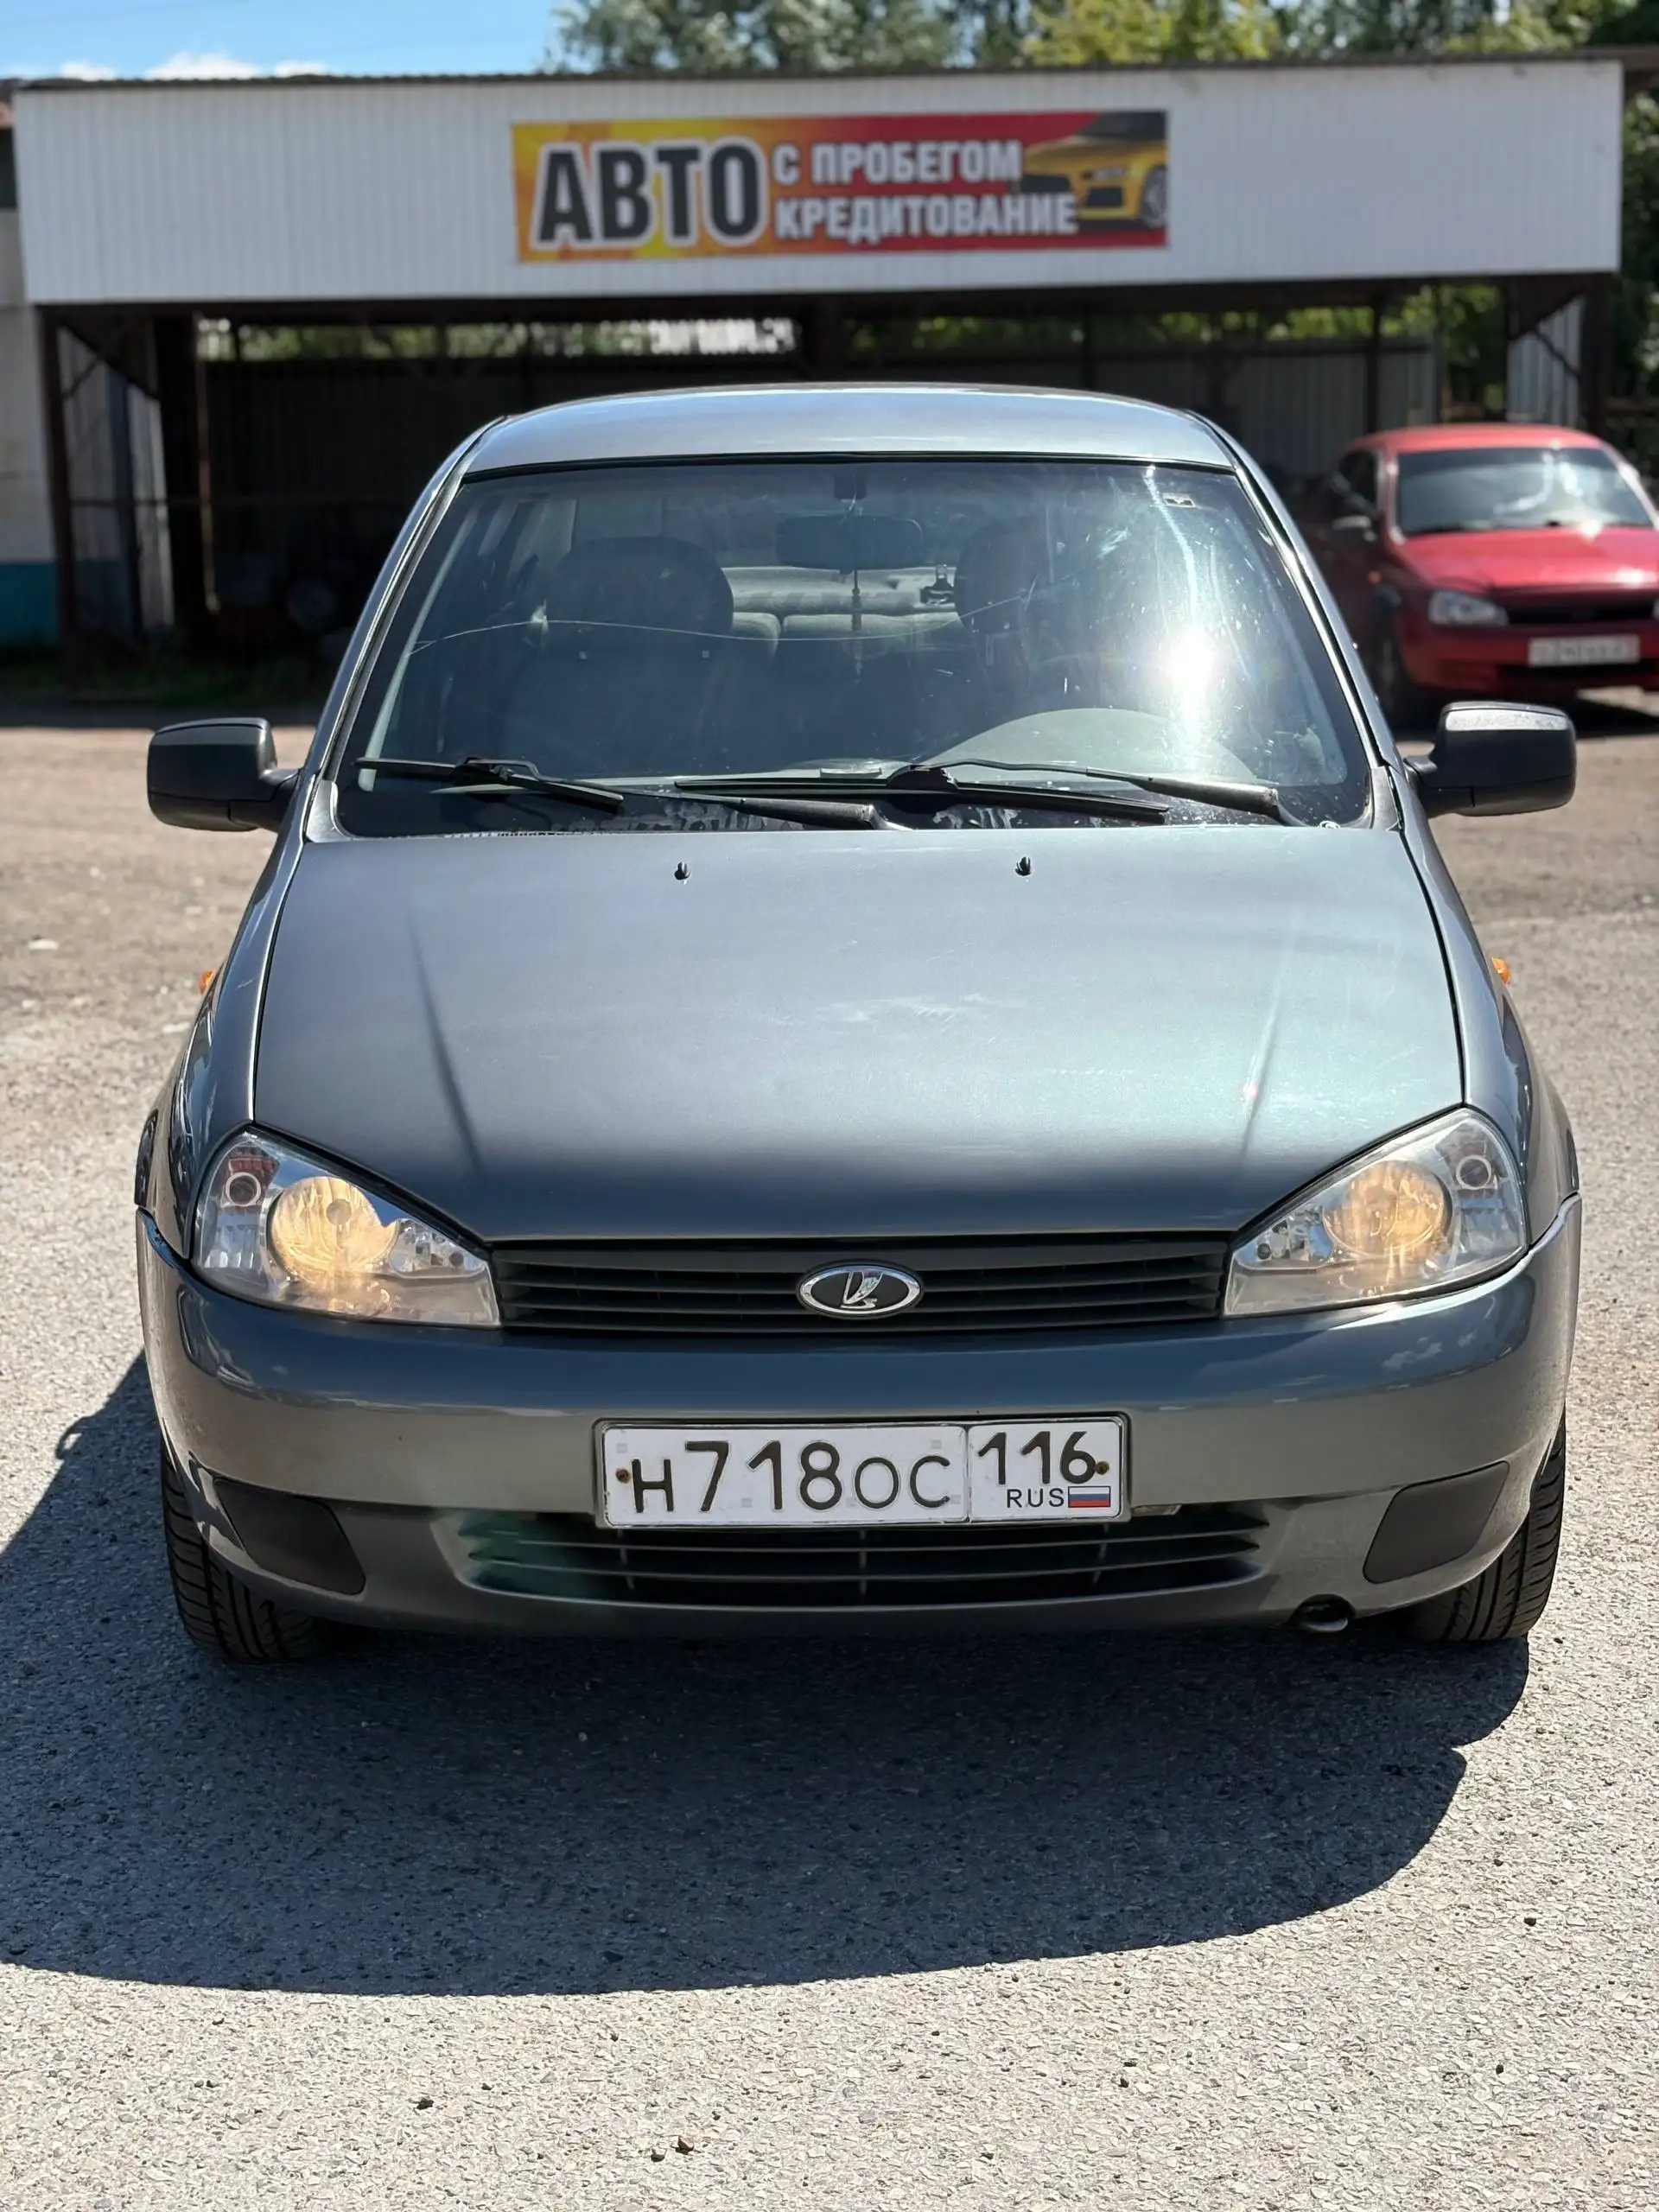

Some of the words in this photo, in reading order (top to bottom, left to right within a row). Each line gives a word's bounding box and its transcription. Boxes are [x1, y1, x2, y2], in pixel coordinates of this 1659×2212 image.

[774, 143, 800, 184] С
[812, 141, 1022, 183] ПРОБЕГОМ
[534, 143, 764, 245] АВТО
[776, 193, 1077, 244] КРЕДИТОВАНИЕ
[977, 1431, 1096, 1485] 116
[1006, 1488, 1065, 1509] RUS
